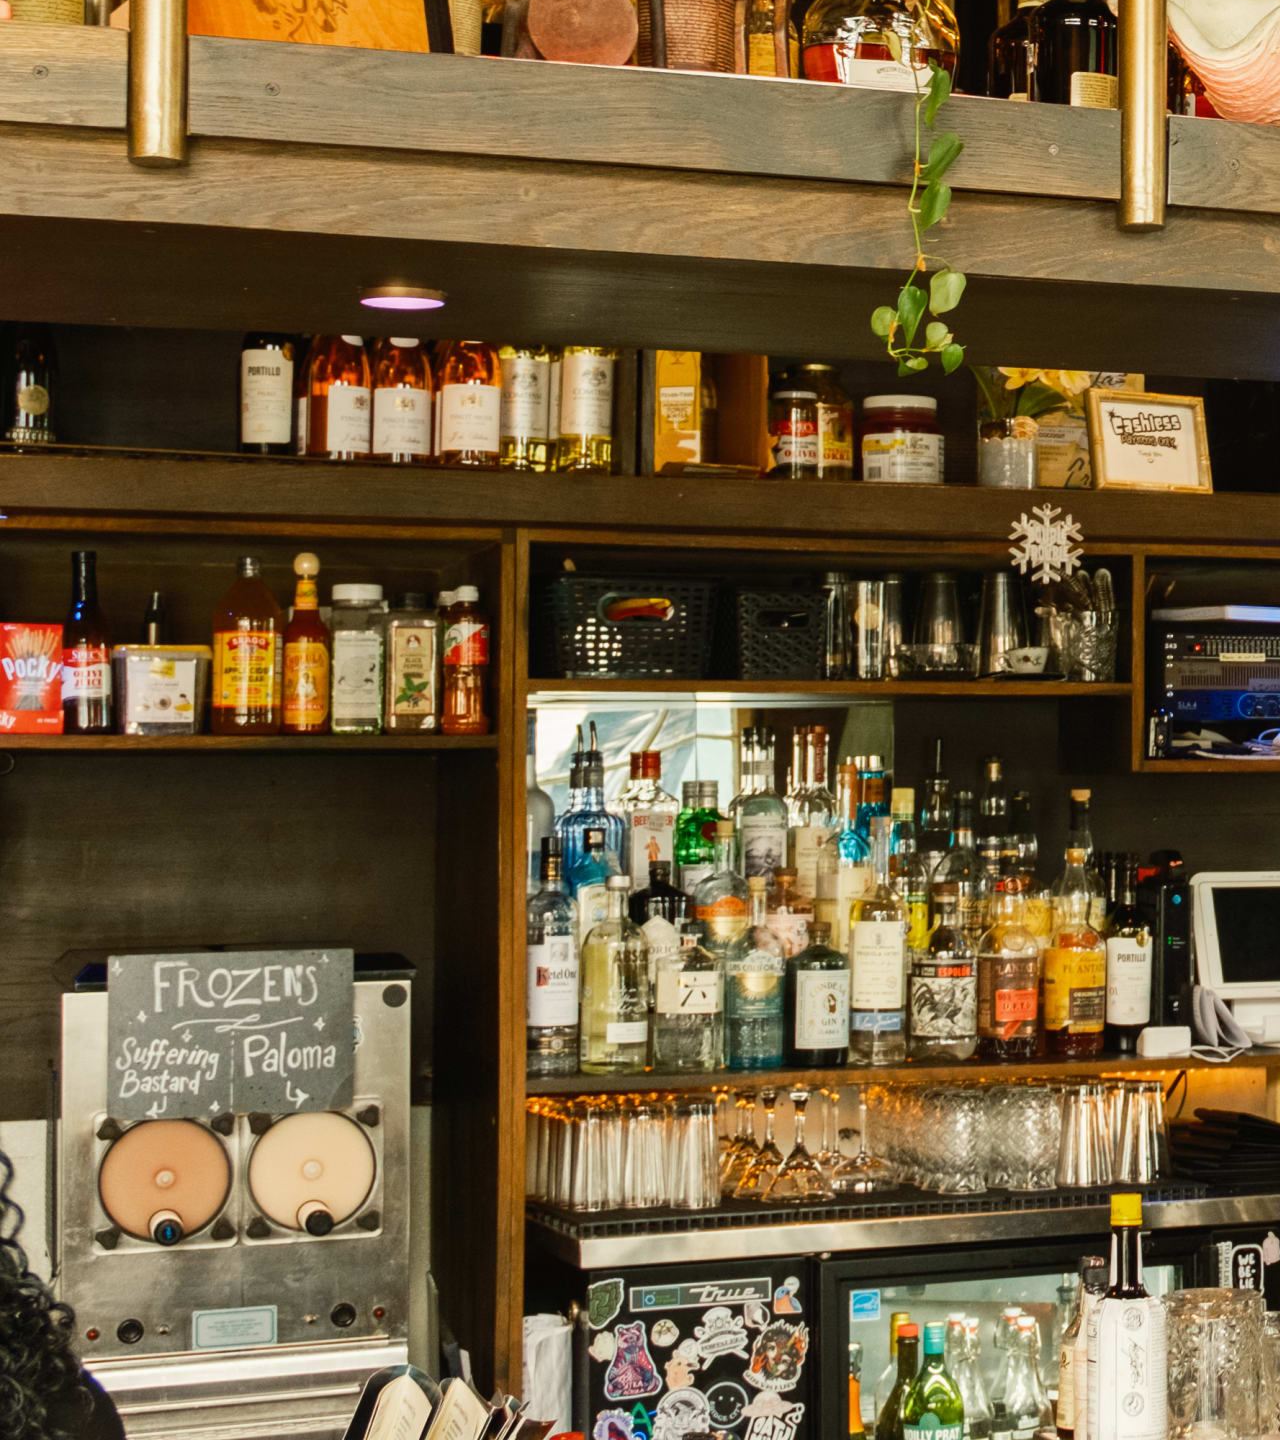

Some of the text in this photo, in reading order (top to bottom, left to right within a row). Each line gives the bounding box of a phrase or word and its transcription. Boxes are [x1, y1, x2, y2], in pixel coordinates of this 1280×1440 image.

[248, 366, 281, 376] PORTILLO
[1111, 412, 1181, 435] Cashless
[0, 711, 17, 729] cky
[1117, 953, 1147, 962] PORTILLO
[153, 960, 319, 1014] FROZENS
[115, 1032, 338, 1081] Suffering Paloma
[119, 1070, 202, 1100] Bastard
[1238, 1252, 1256, 1264] WE
